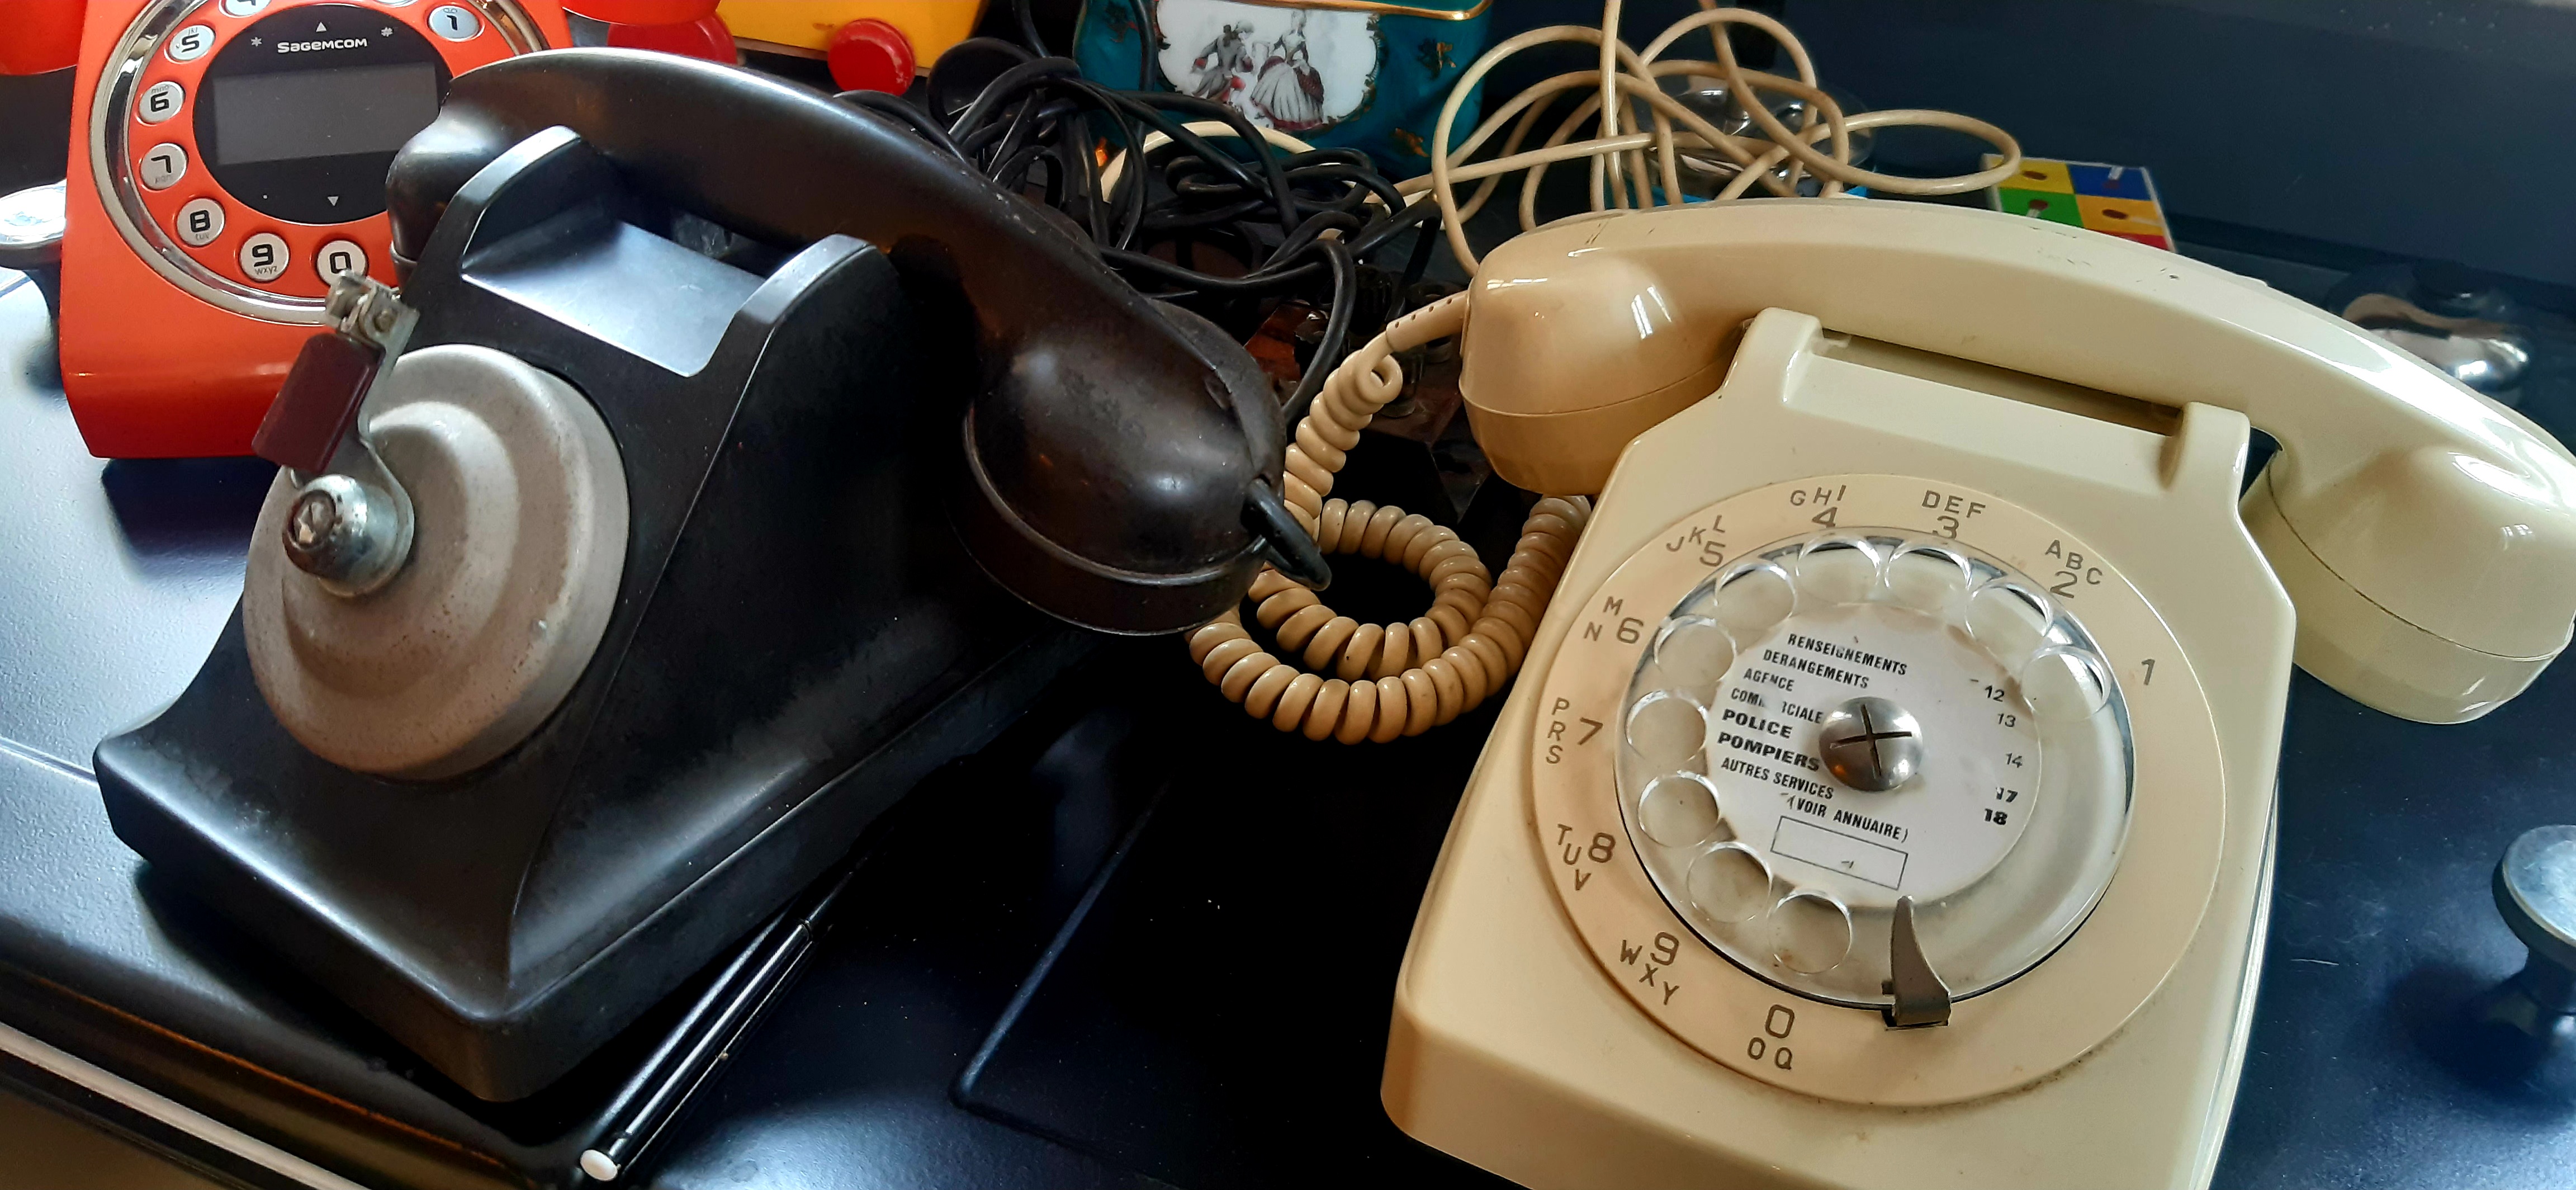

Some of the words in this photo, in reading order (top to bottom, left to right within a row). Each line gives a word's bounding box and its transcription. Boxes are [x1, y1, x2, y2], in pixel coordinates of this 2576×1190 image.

[447, 15, 458, 31] 1
[182, 33, 200, 53] 5
[150, 91, 170, 112] 6
[151, 155, 171, 173] 7
[190, 210, 211, 233] 8
[252, 244, 274, 267] 9
[329, 252, 352, 274] 0
[255, 266, 278, 275] wxyz
[1790, 484, 1846, 506] GHI
[1921, 490, 1986, 518] DEF
[1812, 507, 1838, 528] 4
[1931, 515, 1959, 539] 3
[1699, 541, 1726, 567] 5
[2045, 539, 2103, 585] ABC
[2050, 571, 2077, 598] 2
[1616, 617, 1644, 644] 6
[1788, 633, 1908, 676] RENSEIGNEMENTS
[1743, 668, 1795, 692] AGENCE
[1763, 649, 1870, 689] DERANGEMENTS
[2141, 658, 2156, 686] 1
[1985, 684, 2005, 703] 12
[1578, 717, 1603, 745] 7
[1722, 709, 1793, 739] POLICE
[1997, 713, 2016, 728] 13
[1717, 731, 1820, 771] POMPIERS
[2006, 753, 2023, 768] 14
[1721, 757, 1770, 781] AUTRES
[1773, 771, 1834, 800] SERVICES
[1996, 787, 2018, 803] 17
[1833, 809, 1909, 843] ANNUAIRE)
[1985, 809, 2008, 825] 18
[1588, 832, 1616, 863] 8
[1650, 932, 1679, 966] 9
[1765, 1004, 1795, 1038] 0
